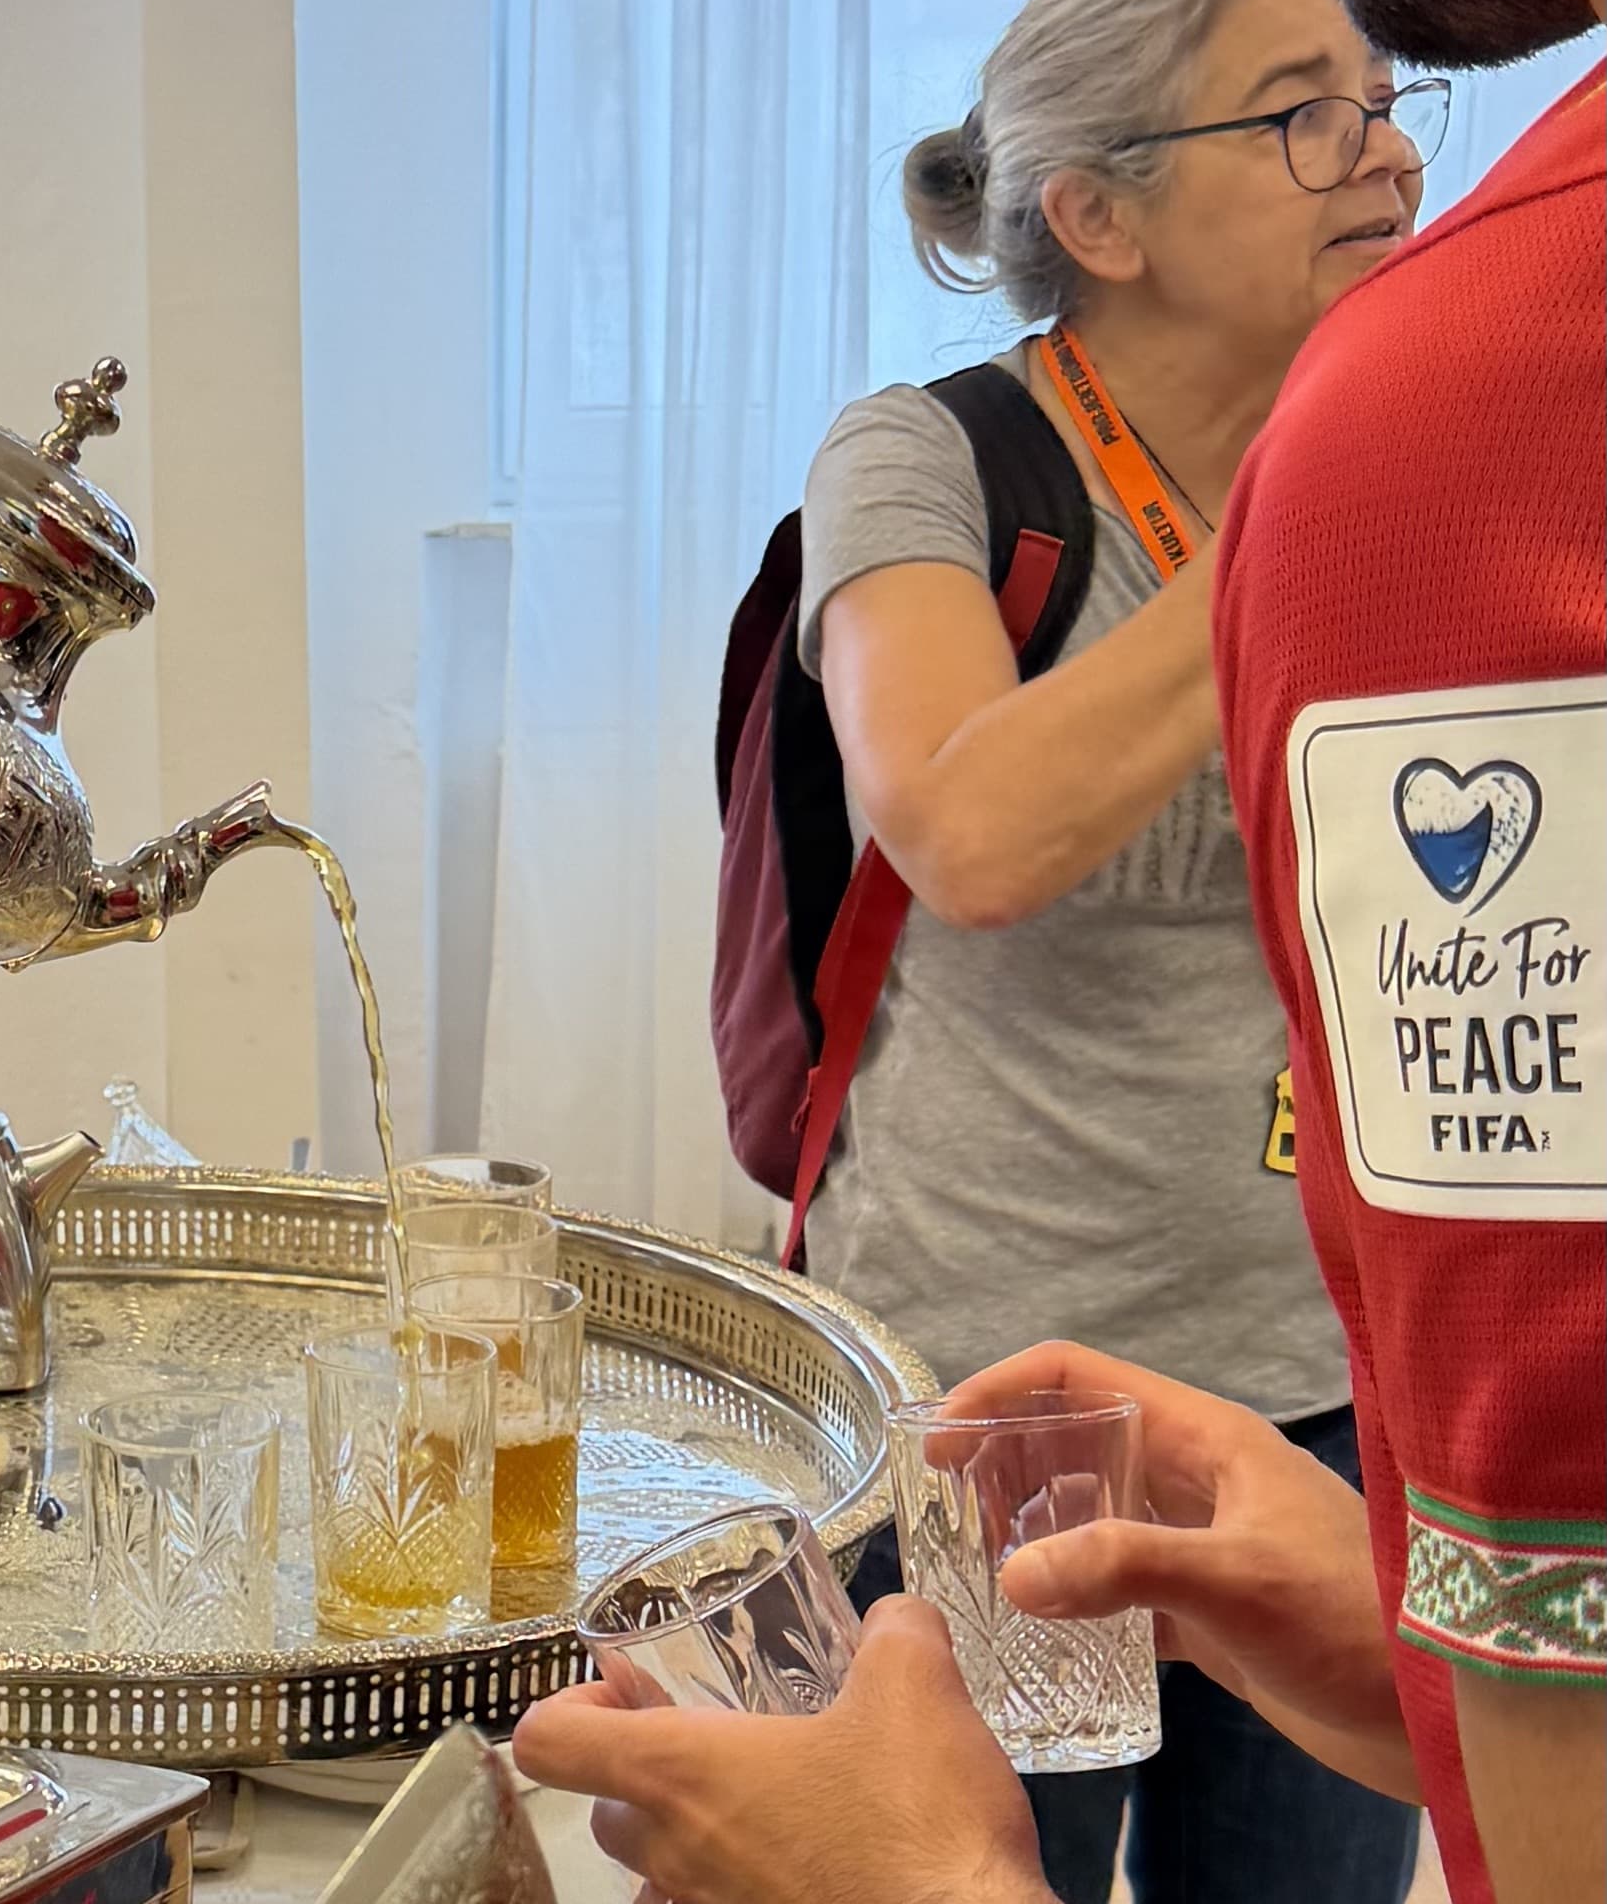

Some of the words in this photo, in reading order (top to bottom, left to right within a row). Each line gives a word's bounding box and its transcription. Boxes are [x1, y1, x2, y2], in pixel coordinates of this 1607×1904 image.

[1142, 500, 1186, 562] KULTUR
[1378, 918, 1498, 1005] Unite
[1502, 917, 1591, 999] For
[1394, 1013, 1582, 1094] PEACE
[1430, 1114, 1538, 1153] FIFA
